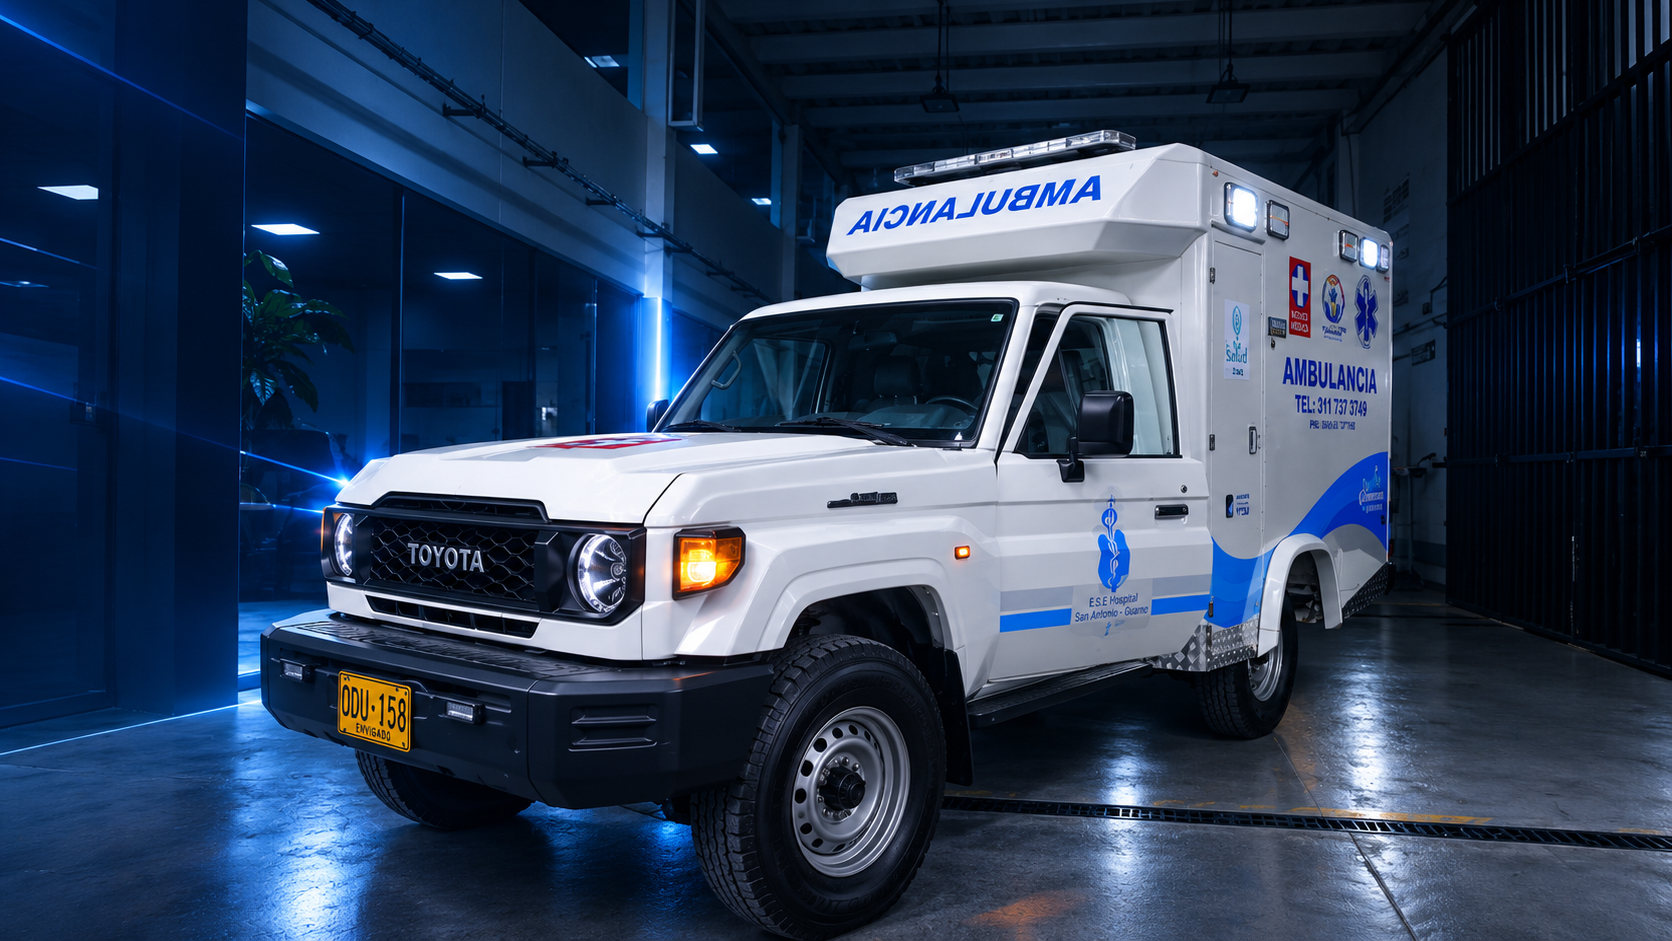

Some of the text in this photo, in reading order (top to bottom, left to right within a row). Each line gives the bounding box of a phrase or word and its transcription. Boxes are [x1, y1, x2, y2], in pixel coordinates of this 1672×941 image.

[1282, 356, 1377, 394] AMBULANCIA
[1295, 394, 1367, 417] TEL: 311 737 3749
[407, 542, 485, 573] TOYOTA
[1109, 593, 1138, 606] Hospital
[1075, 612, 1089, 622] San
[356, 722, 391, 742] ENVIGADO
